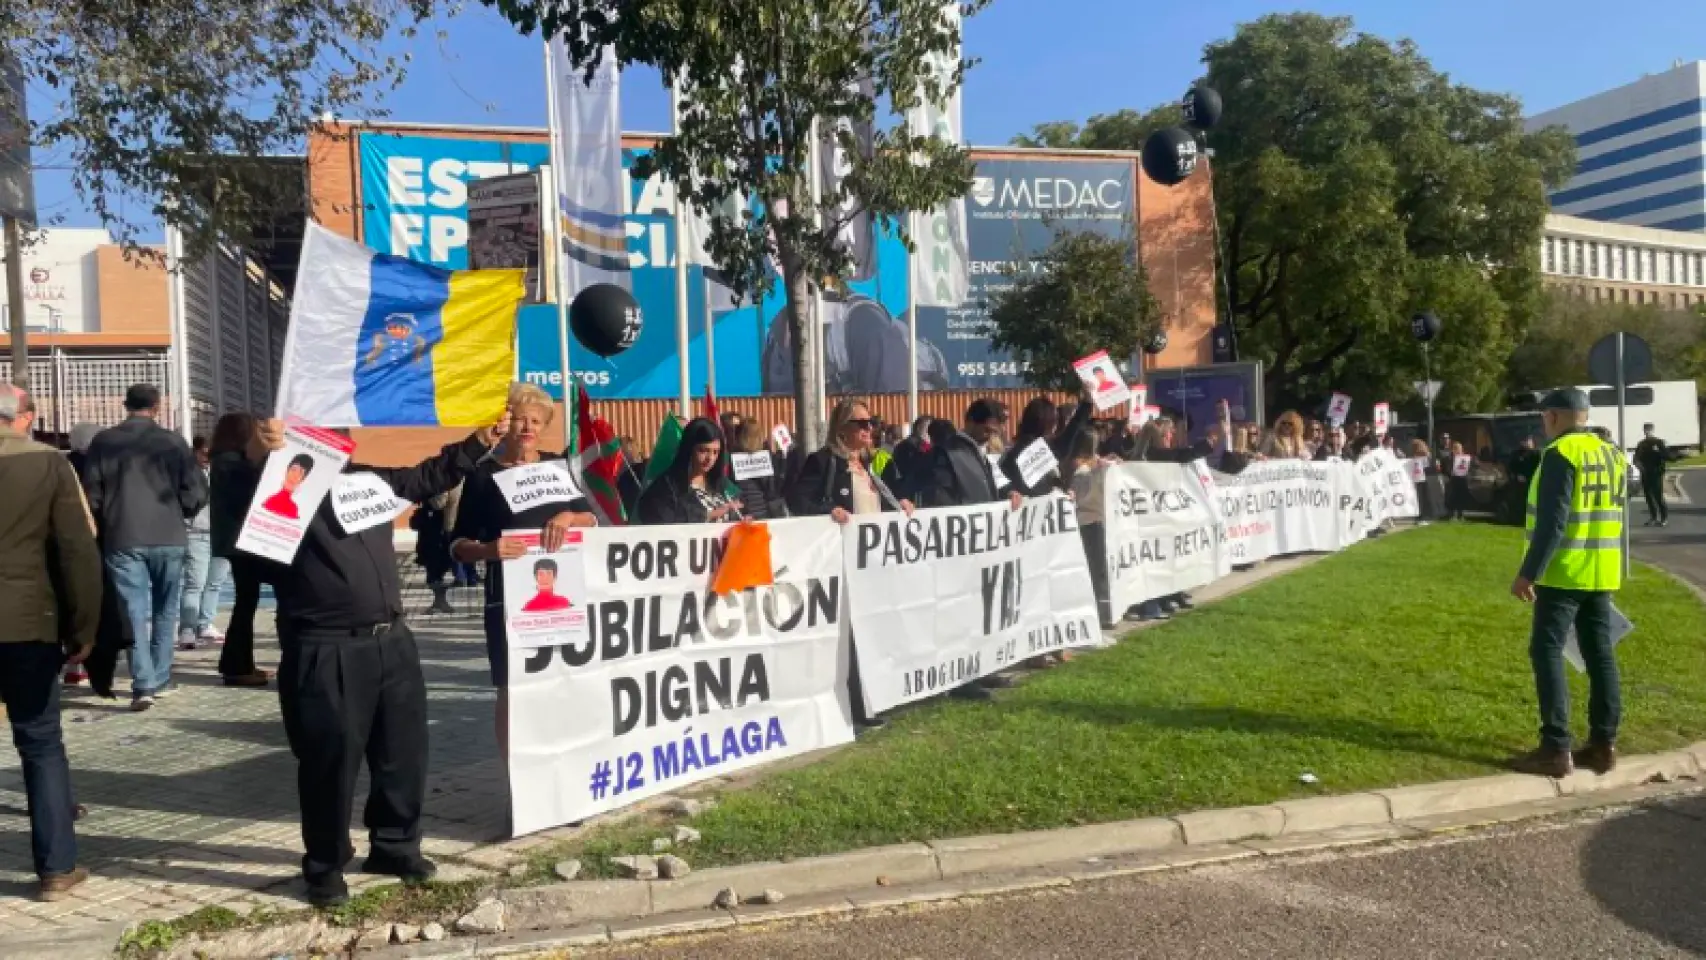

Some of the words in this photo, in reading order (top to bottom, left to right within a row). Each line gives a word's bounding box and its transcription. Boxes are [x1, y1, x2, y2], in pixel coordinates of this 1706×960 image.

[998, 177, 1122, 209] MEDAC
[390, 212, 469, 263] FP
[957, 361, 985, 376] 955
[989, 361, 1017, 376] 544
[607, 538, 679, 584] POR
[689, 536, 729, 575] UN
[856, 508, 1011, 570] PASARELA
[980, 556, 1023, 636] YA!
[610, 652, 770, 738] DIGNA
[588, 751, 645, 801] #J2
[652, 715, 788, 782] MÁLAGA
